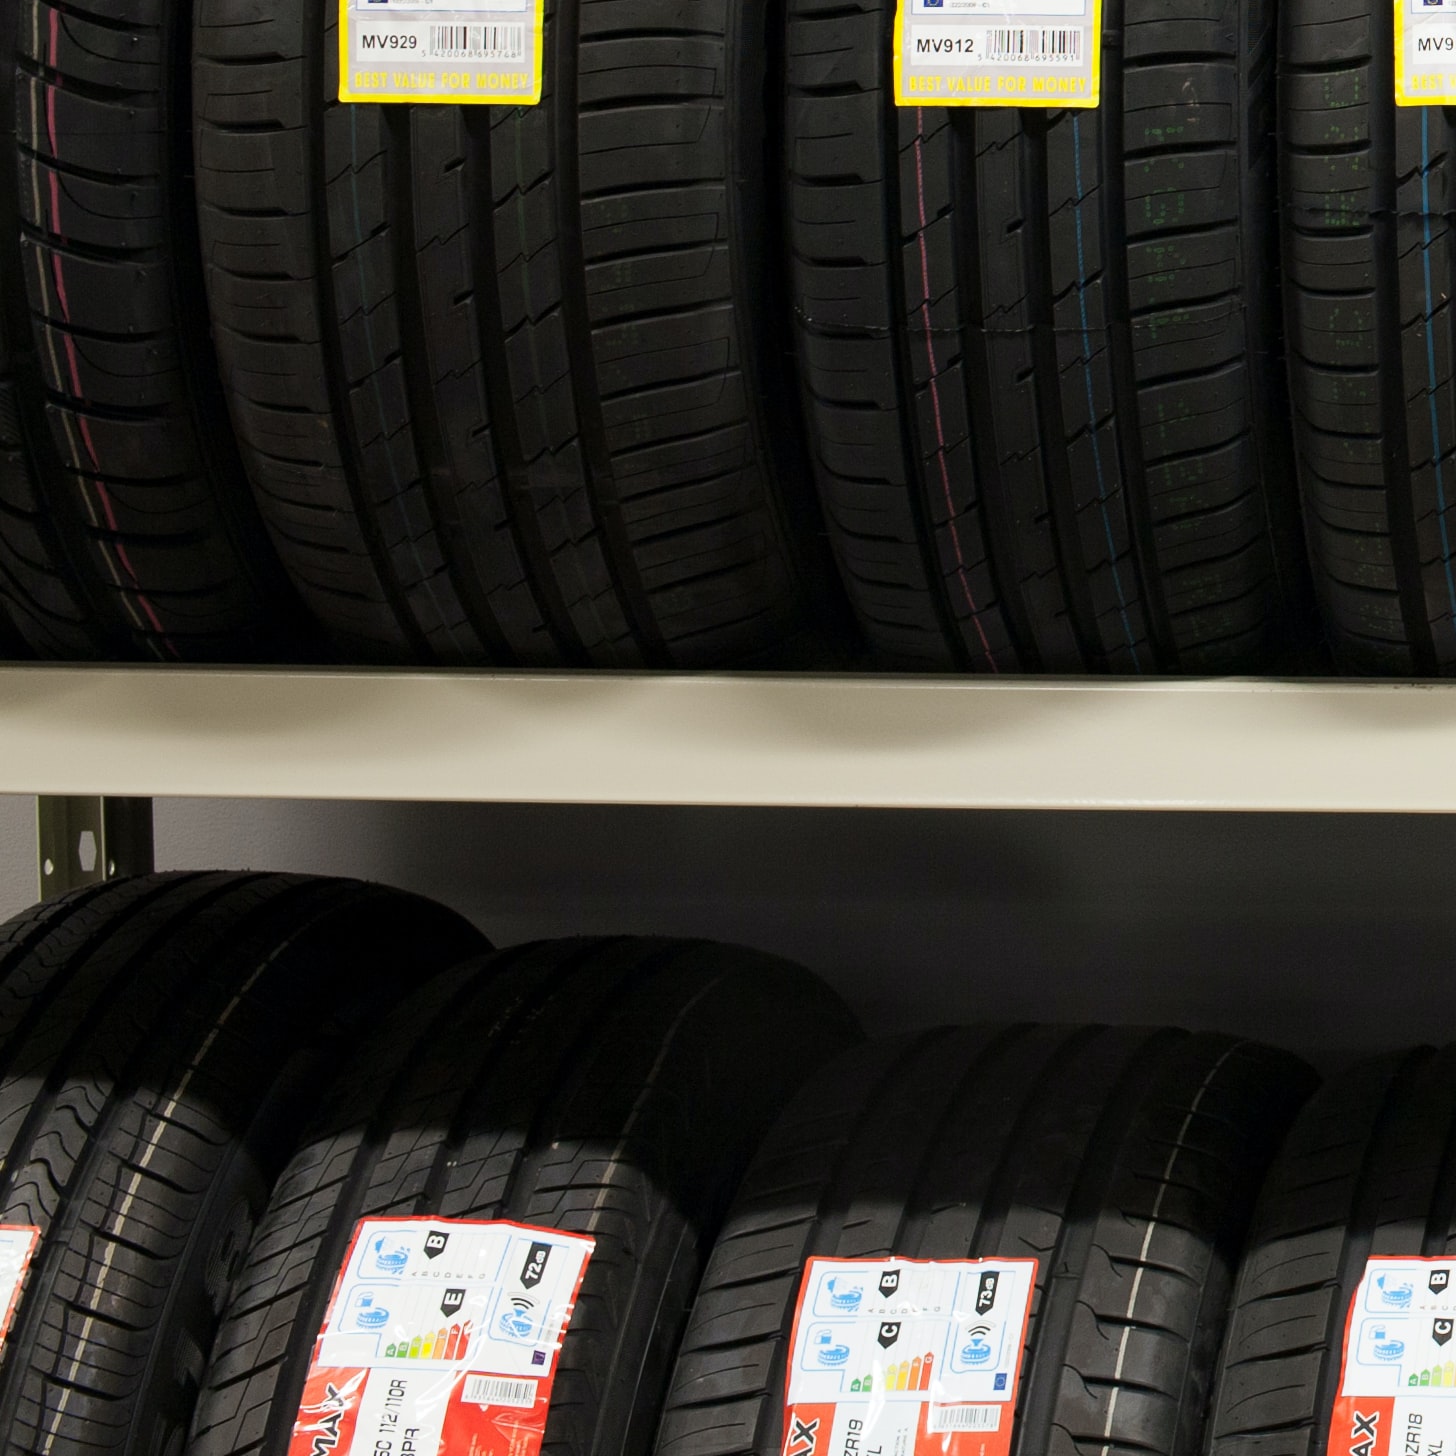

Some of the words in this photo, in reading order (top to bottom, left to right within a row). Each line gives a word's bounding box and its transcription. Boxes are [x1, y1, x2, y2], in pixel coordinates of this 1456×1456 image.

[362, 35, 417, 49] MV929
[916, 39, 974, 53] MV912
[355, 73, 387, 88] BEST
[393, 72, 436, 89] VALUE
[441, 73, 471, 89] FOR
[476, 73, 529, 90] MONEY
[909, 75, 942, 92] BEST
[947, 75, 991, 91] VALUE
[997, 75, 1026, 91] FOR
[1032, 75, 1087, 92] MONEY
[427, 1234, 445, 1249] B
[881, 1274, 898, 1288] B
[1431, 1272, 1447, 1285] B
[445, 1292, 462, 1306] E
[881, 1324, 899, 1338] C
[1434, 1321, 1451, 1334] C
